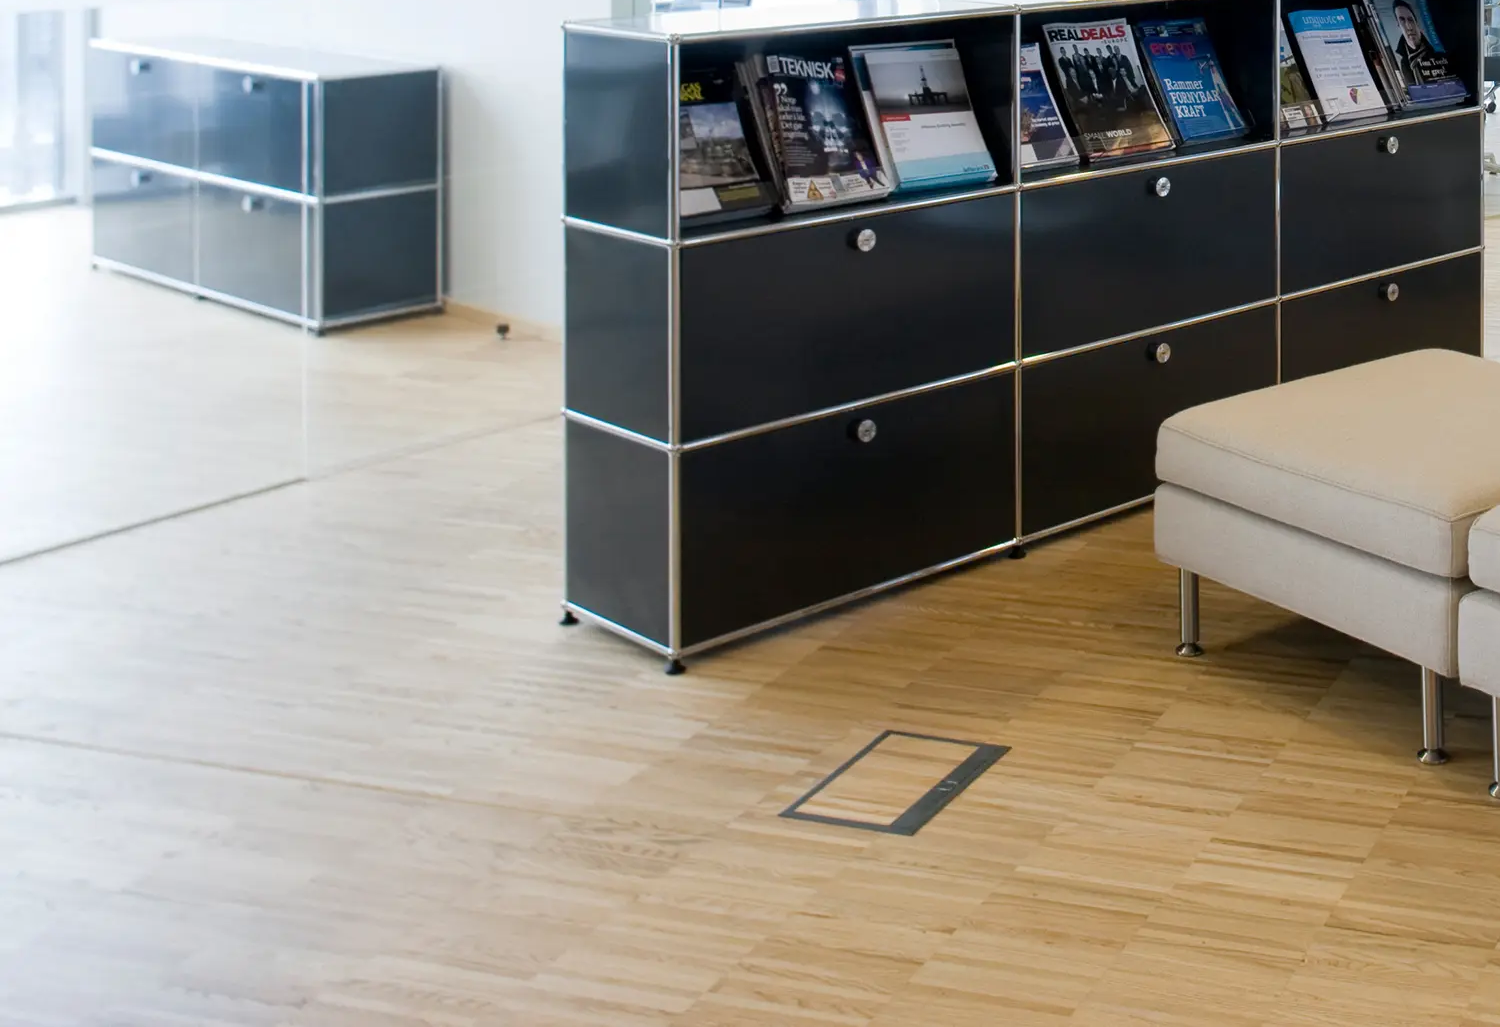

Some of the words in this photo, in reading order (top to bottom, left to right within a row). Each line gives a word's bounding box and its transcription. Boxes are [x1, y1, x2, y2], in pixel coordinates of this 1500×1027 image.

[778, 57, 835, 79] TEKNISK
[1163, 78, 1204, 90] Rammer
[1169, 89, 1222, 104] FORNYBAR
[1175, 105, 1207, 118] KRAFT
[1106, 128, 1133, 138] WORLD
